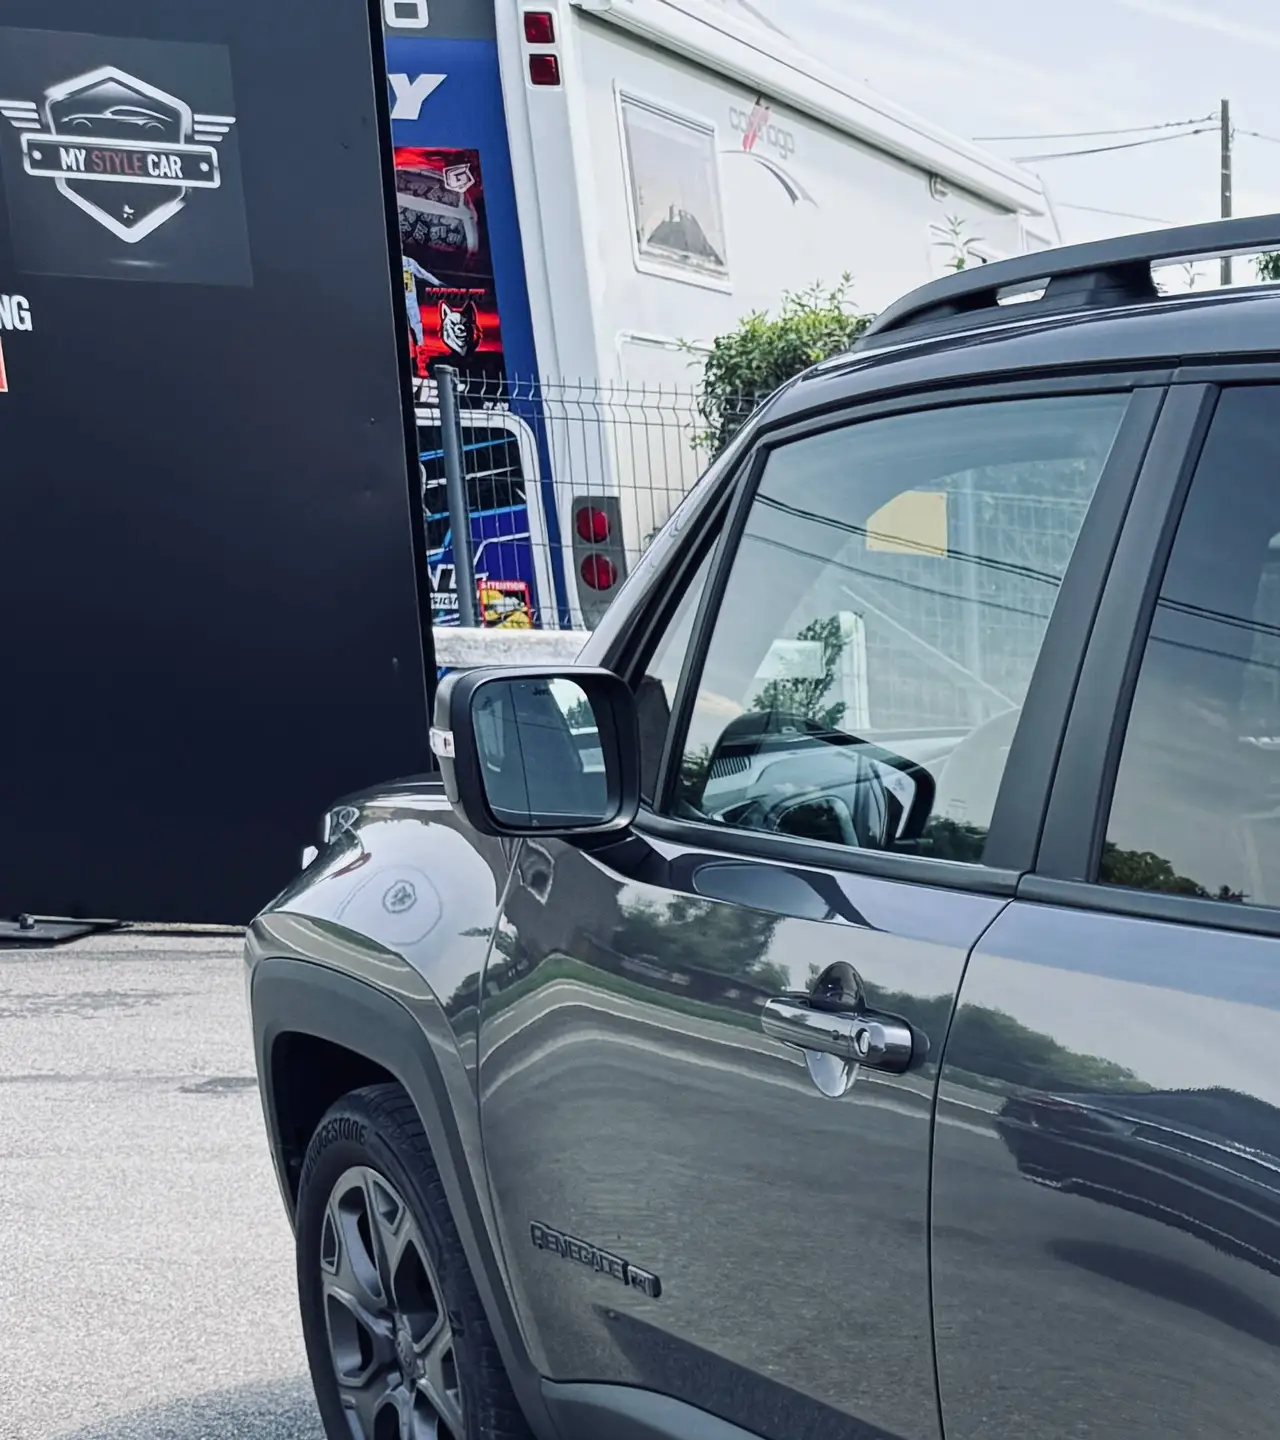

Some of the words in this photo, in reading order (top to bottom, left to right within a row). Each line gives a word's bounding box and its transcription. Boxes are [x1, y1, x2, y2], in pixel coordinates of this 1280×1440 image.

[59, 147, 86, 172] MY
[92, 151, 143, 175] STYLE
[147, 153, 183, 179] CAR
